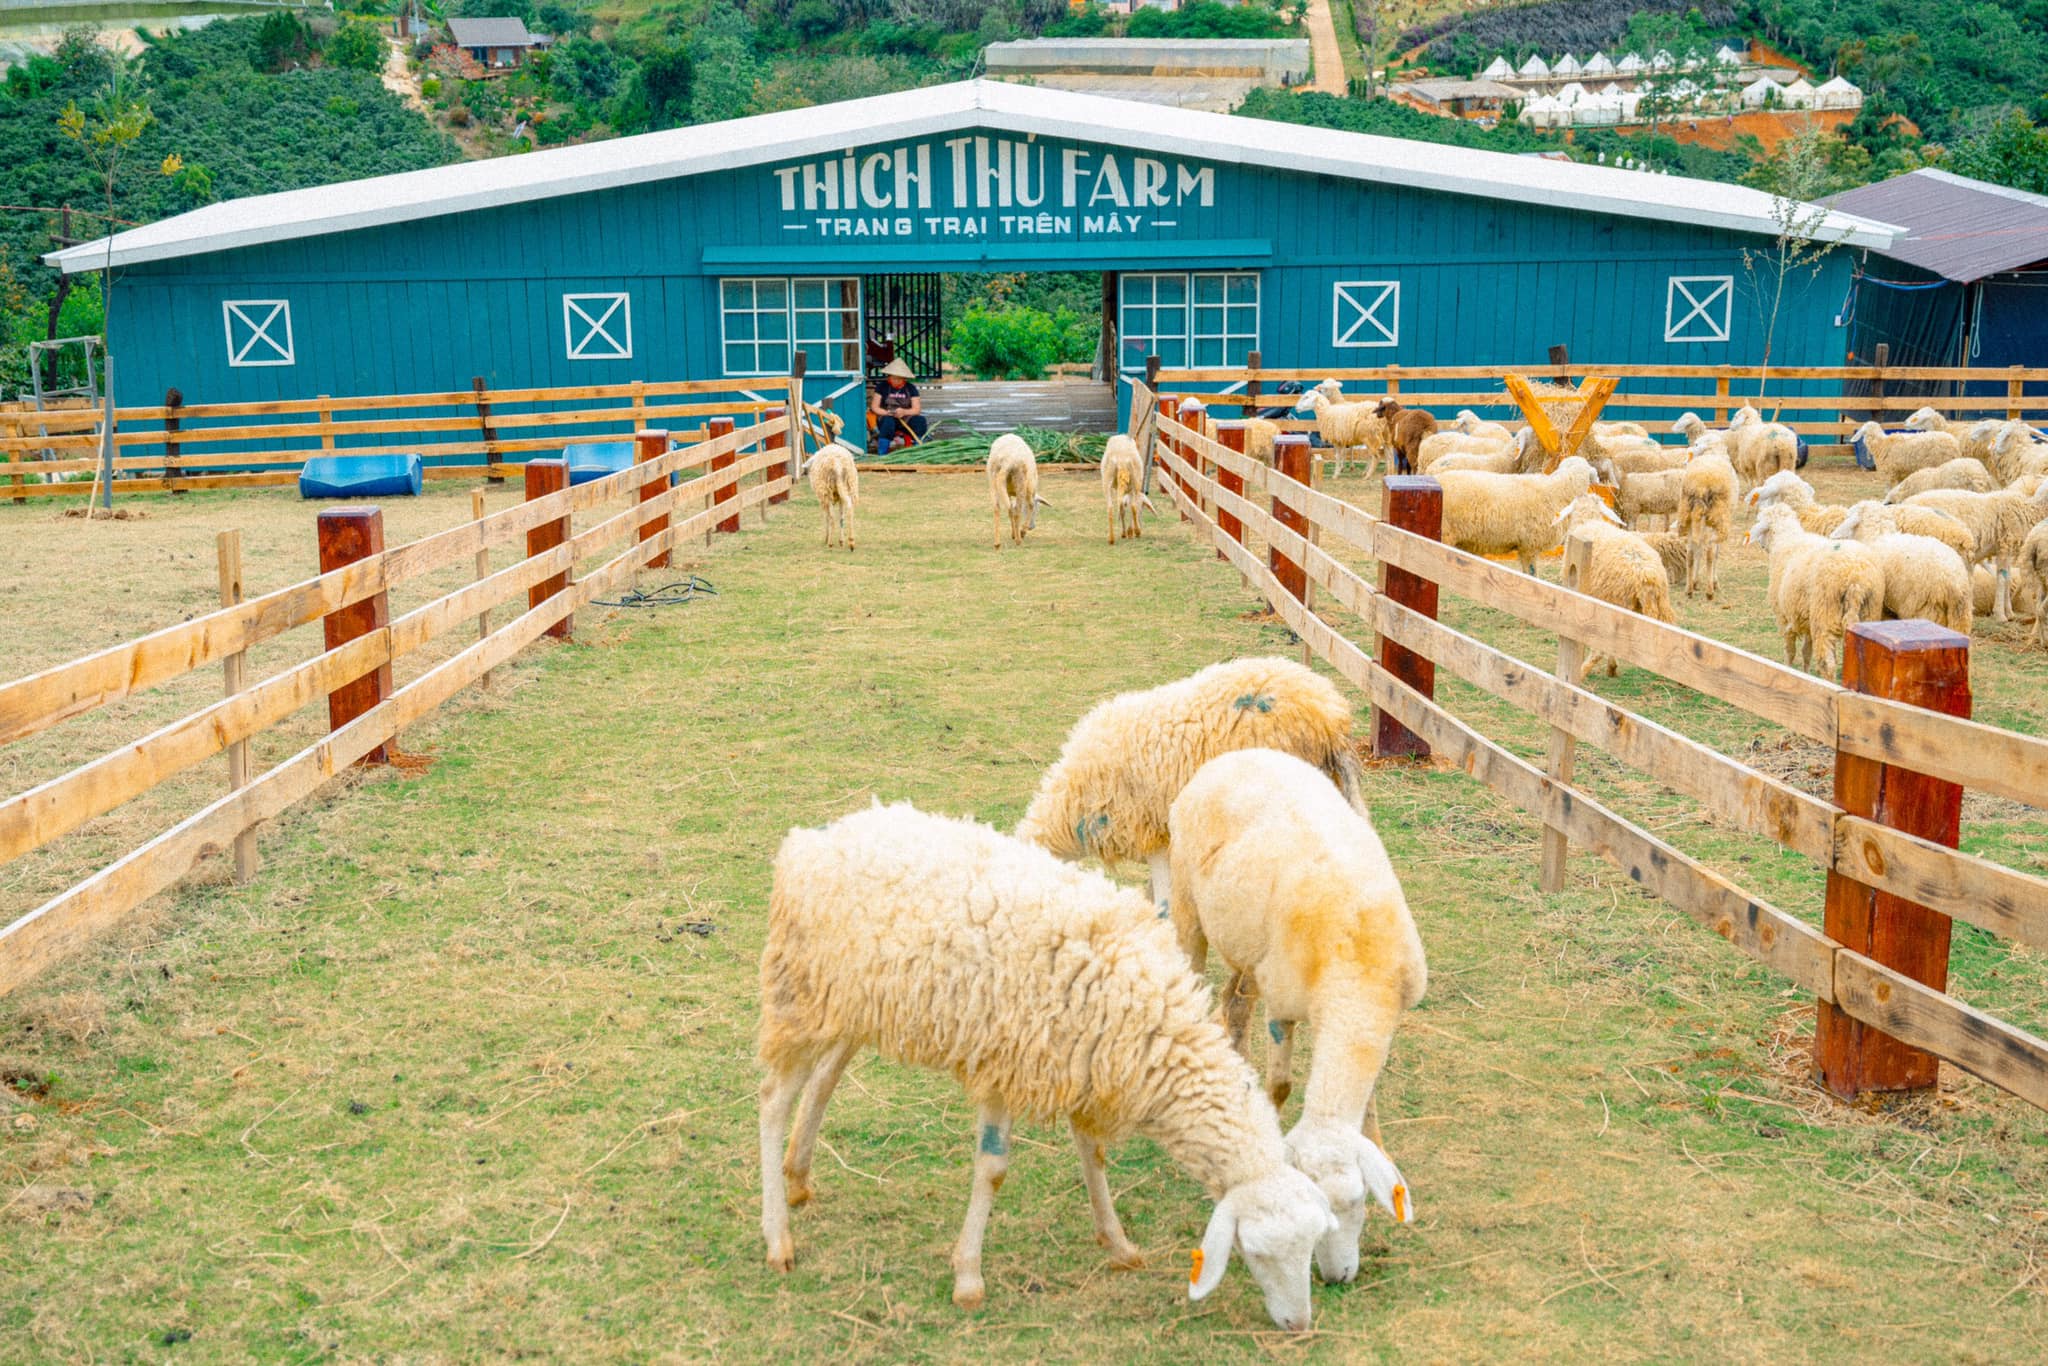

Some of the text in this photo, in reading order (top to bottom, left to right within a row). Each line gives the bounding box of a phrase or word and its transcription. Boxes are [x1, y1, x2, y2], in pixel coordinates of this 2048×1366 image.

[773, 133, 1214, 211] THÍCH THÚ FARM
[815, 211, 1142, 237] TRANG TRẠI TRÊN MÂY
